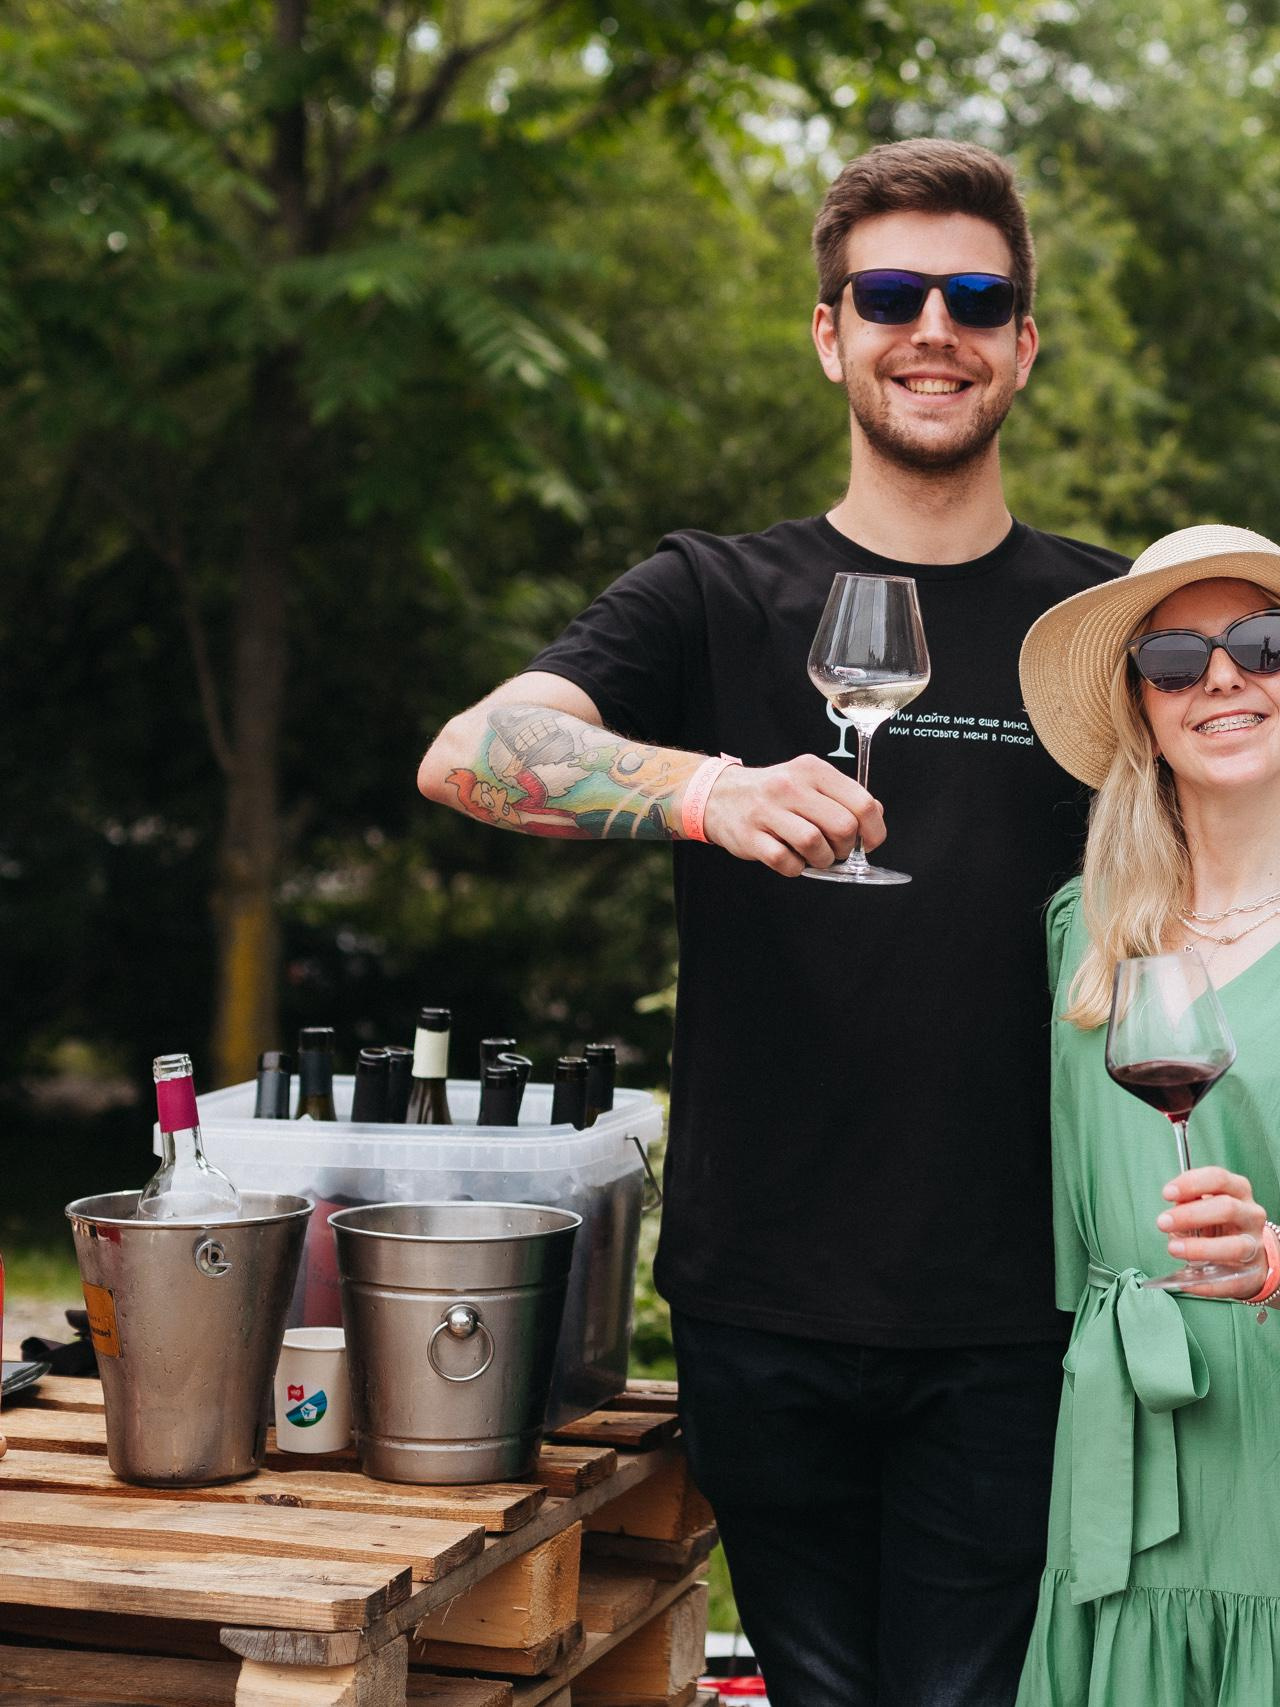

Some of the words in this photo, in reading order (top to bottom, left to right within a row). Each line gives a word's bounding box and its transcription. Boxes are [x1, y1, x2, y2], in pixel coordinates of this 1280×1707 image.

[916, 713, 950, 725] дайте
[953, 716, 976, 726] мне
[978, 718, 1000, 728] еще
[889, 726, 910, 736] или
[913, 728, 960, 740] оставьте
[963, 731, 988, 741] меня
[1000, 734, 1035, 746] покое!
